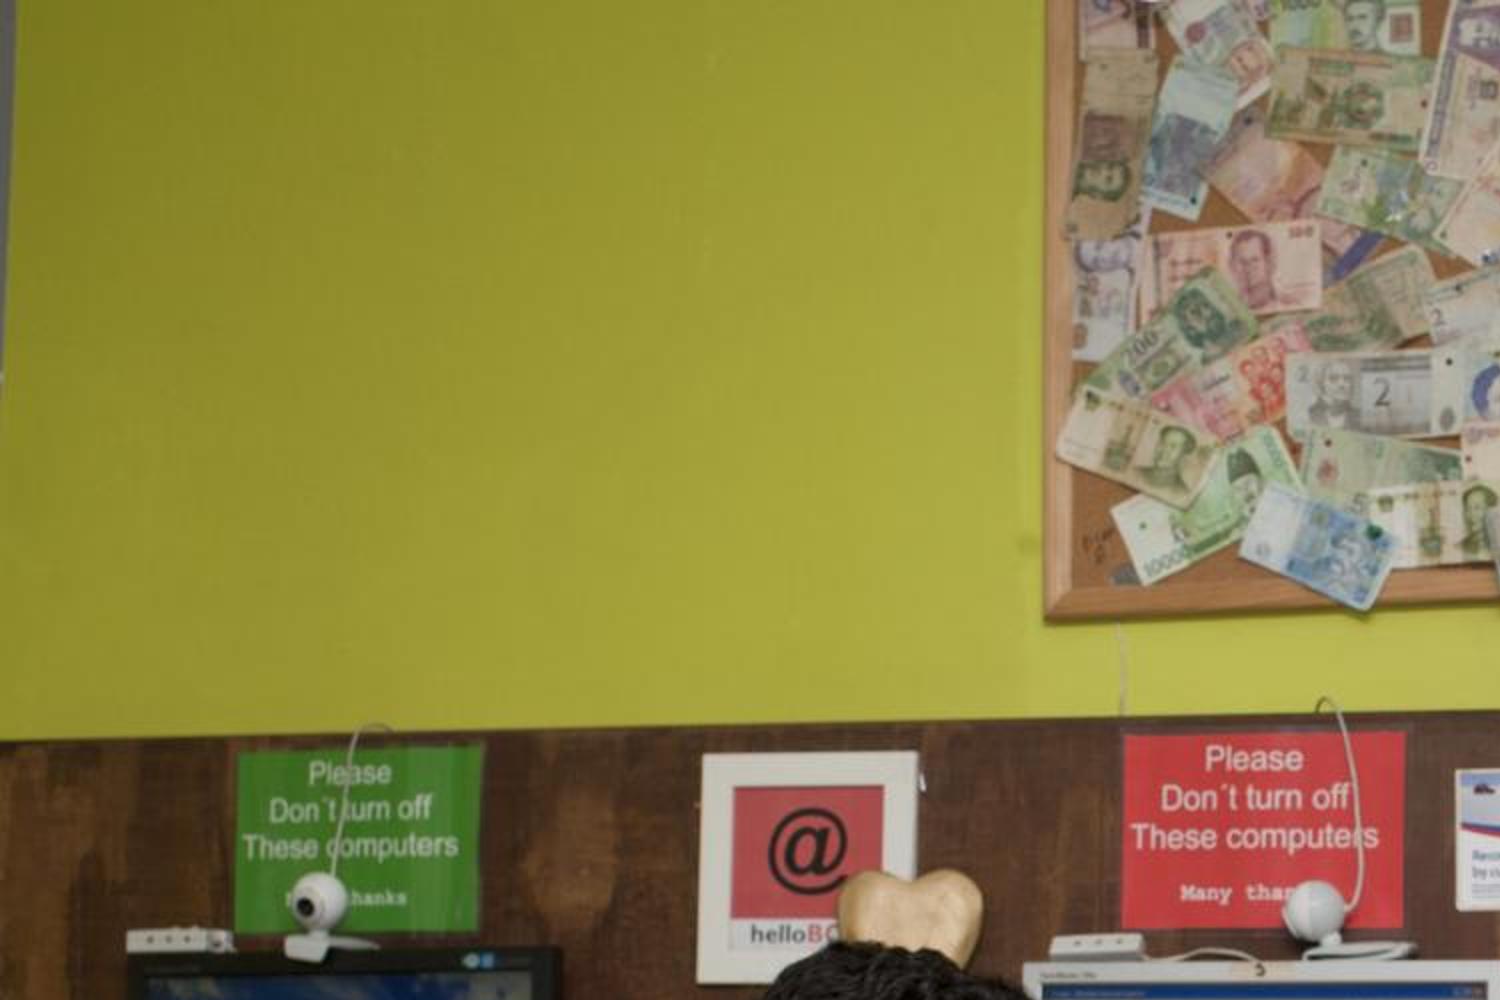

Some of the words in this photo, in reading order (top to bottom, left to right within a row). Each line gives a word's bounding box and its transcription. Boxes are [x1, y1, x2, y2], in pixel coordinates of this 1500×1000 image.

[1373, 377, 1392, 407] 2
[1204, 744, 1304, 772] Please
[308, 760, 392, 787] Please
[343, 798, 390, 823] urn
[397, 792, 433, 820] off
[1246, 784, 1303, 811] turn
[1312, 781, 1350, 811] off
[243, 833, 319, 861] These
[325, 832, 459, 864] computers
[1130, 823, 1217, 850] These
[1226, 822, 1380, 856] computers
[351, 891, 407, 907] hanks
[1180, 885, 1231, 906] Many
[1247, 883, 1296, 902] tha
[751, 924, 838, 944] helloBC
